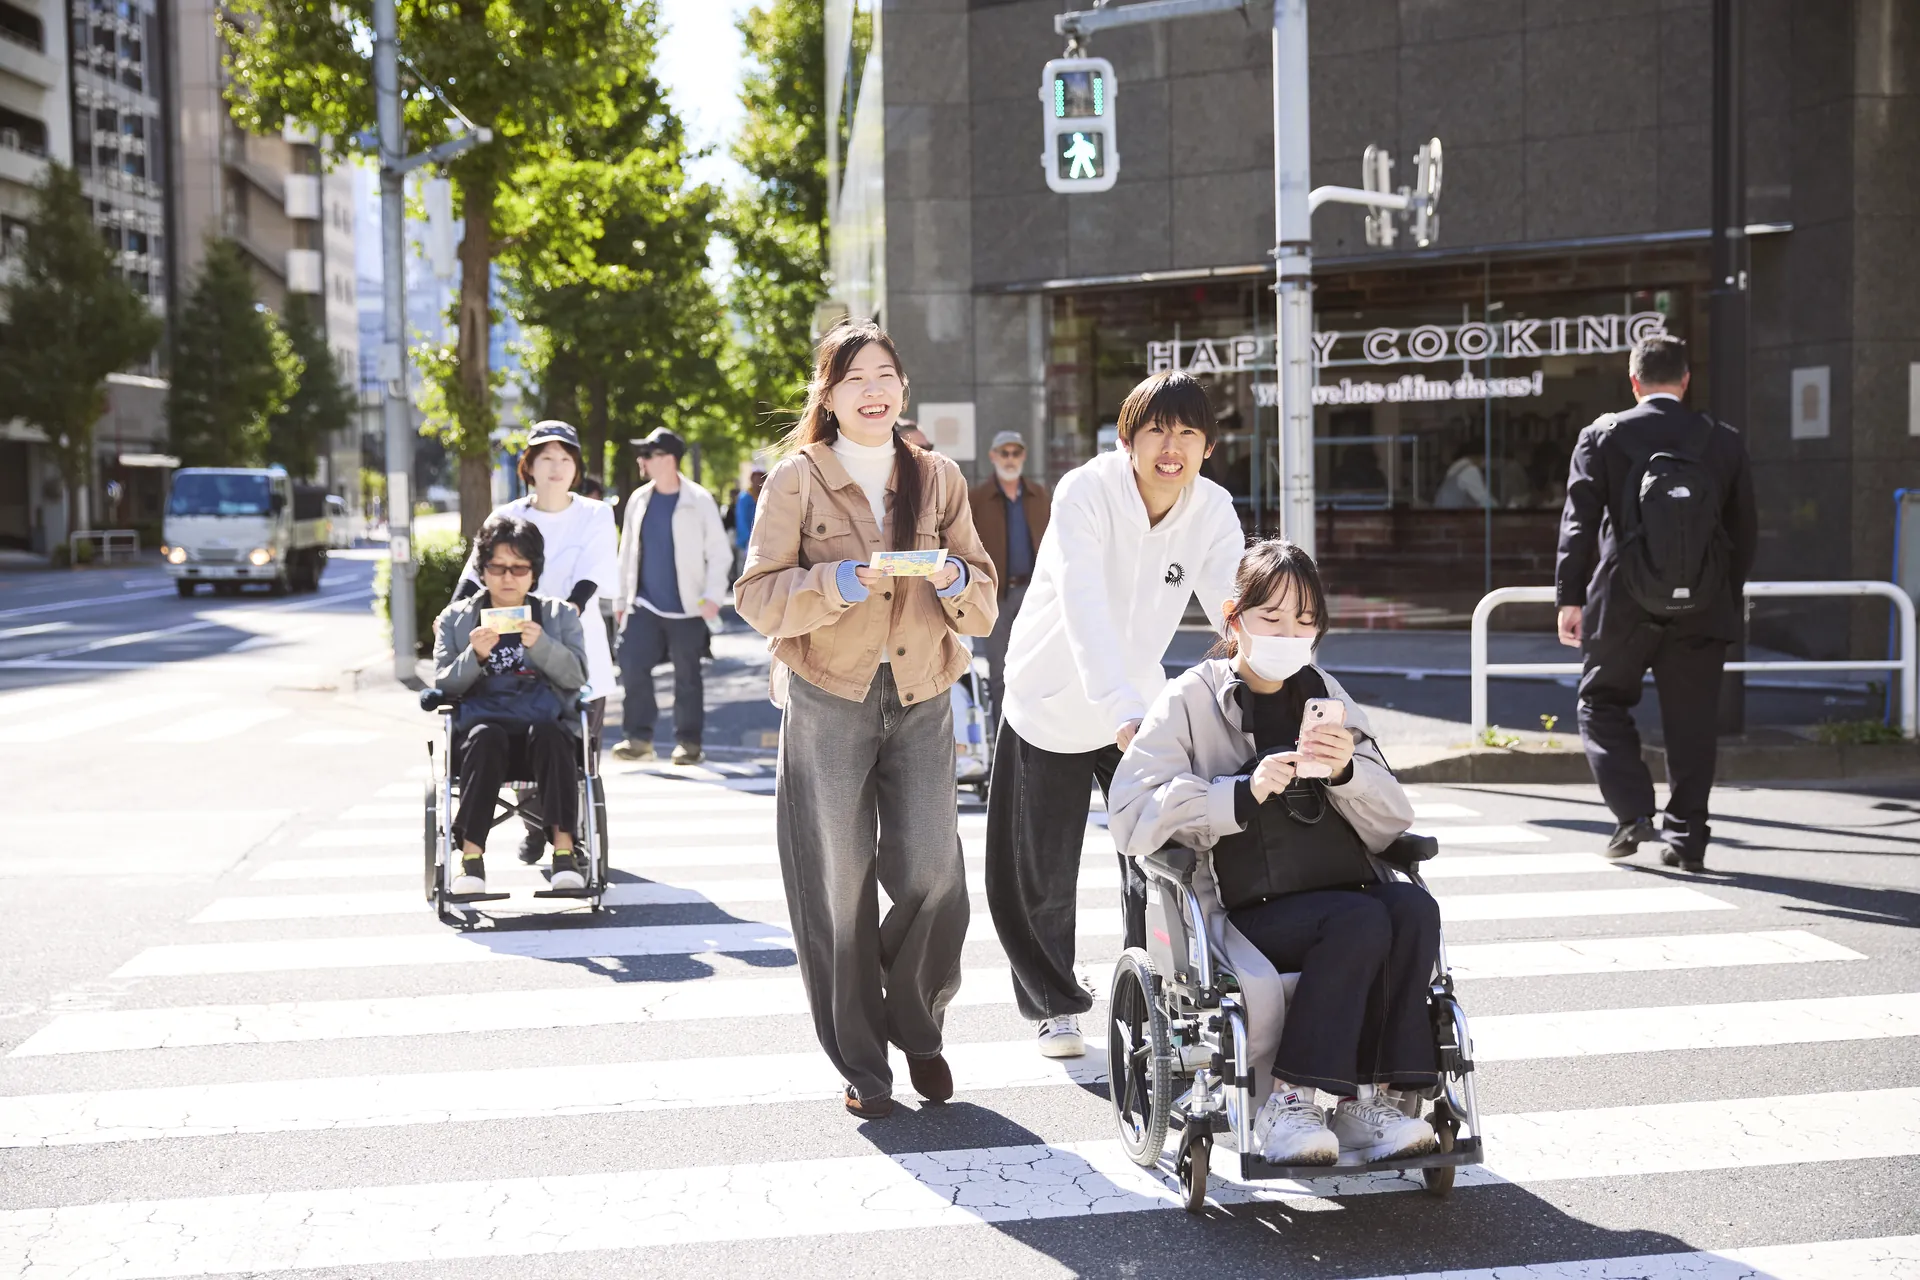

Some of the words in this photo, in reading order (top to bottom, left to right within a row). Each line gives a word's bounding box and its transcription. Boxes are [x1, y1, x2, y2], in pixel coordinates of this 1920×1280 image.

[1147, 331, 1338, 375] HAPY
[1363, 311, 1667, 365] COOKING
[1250, 382, 1280, 407] W
[1340, 377, 1384, 404] lots
